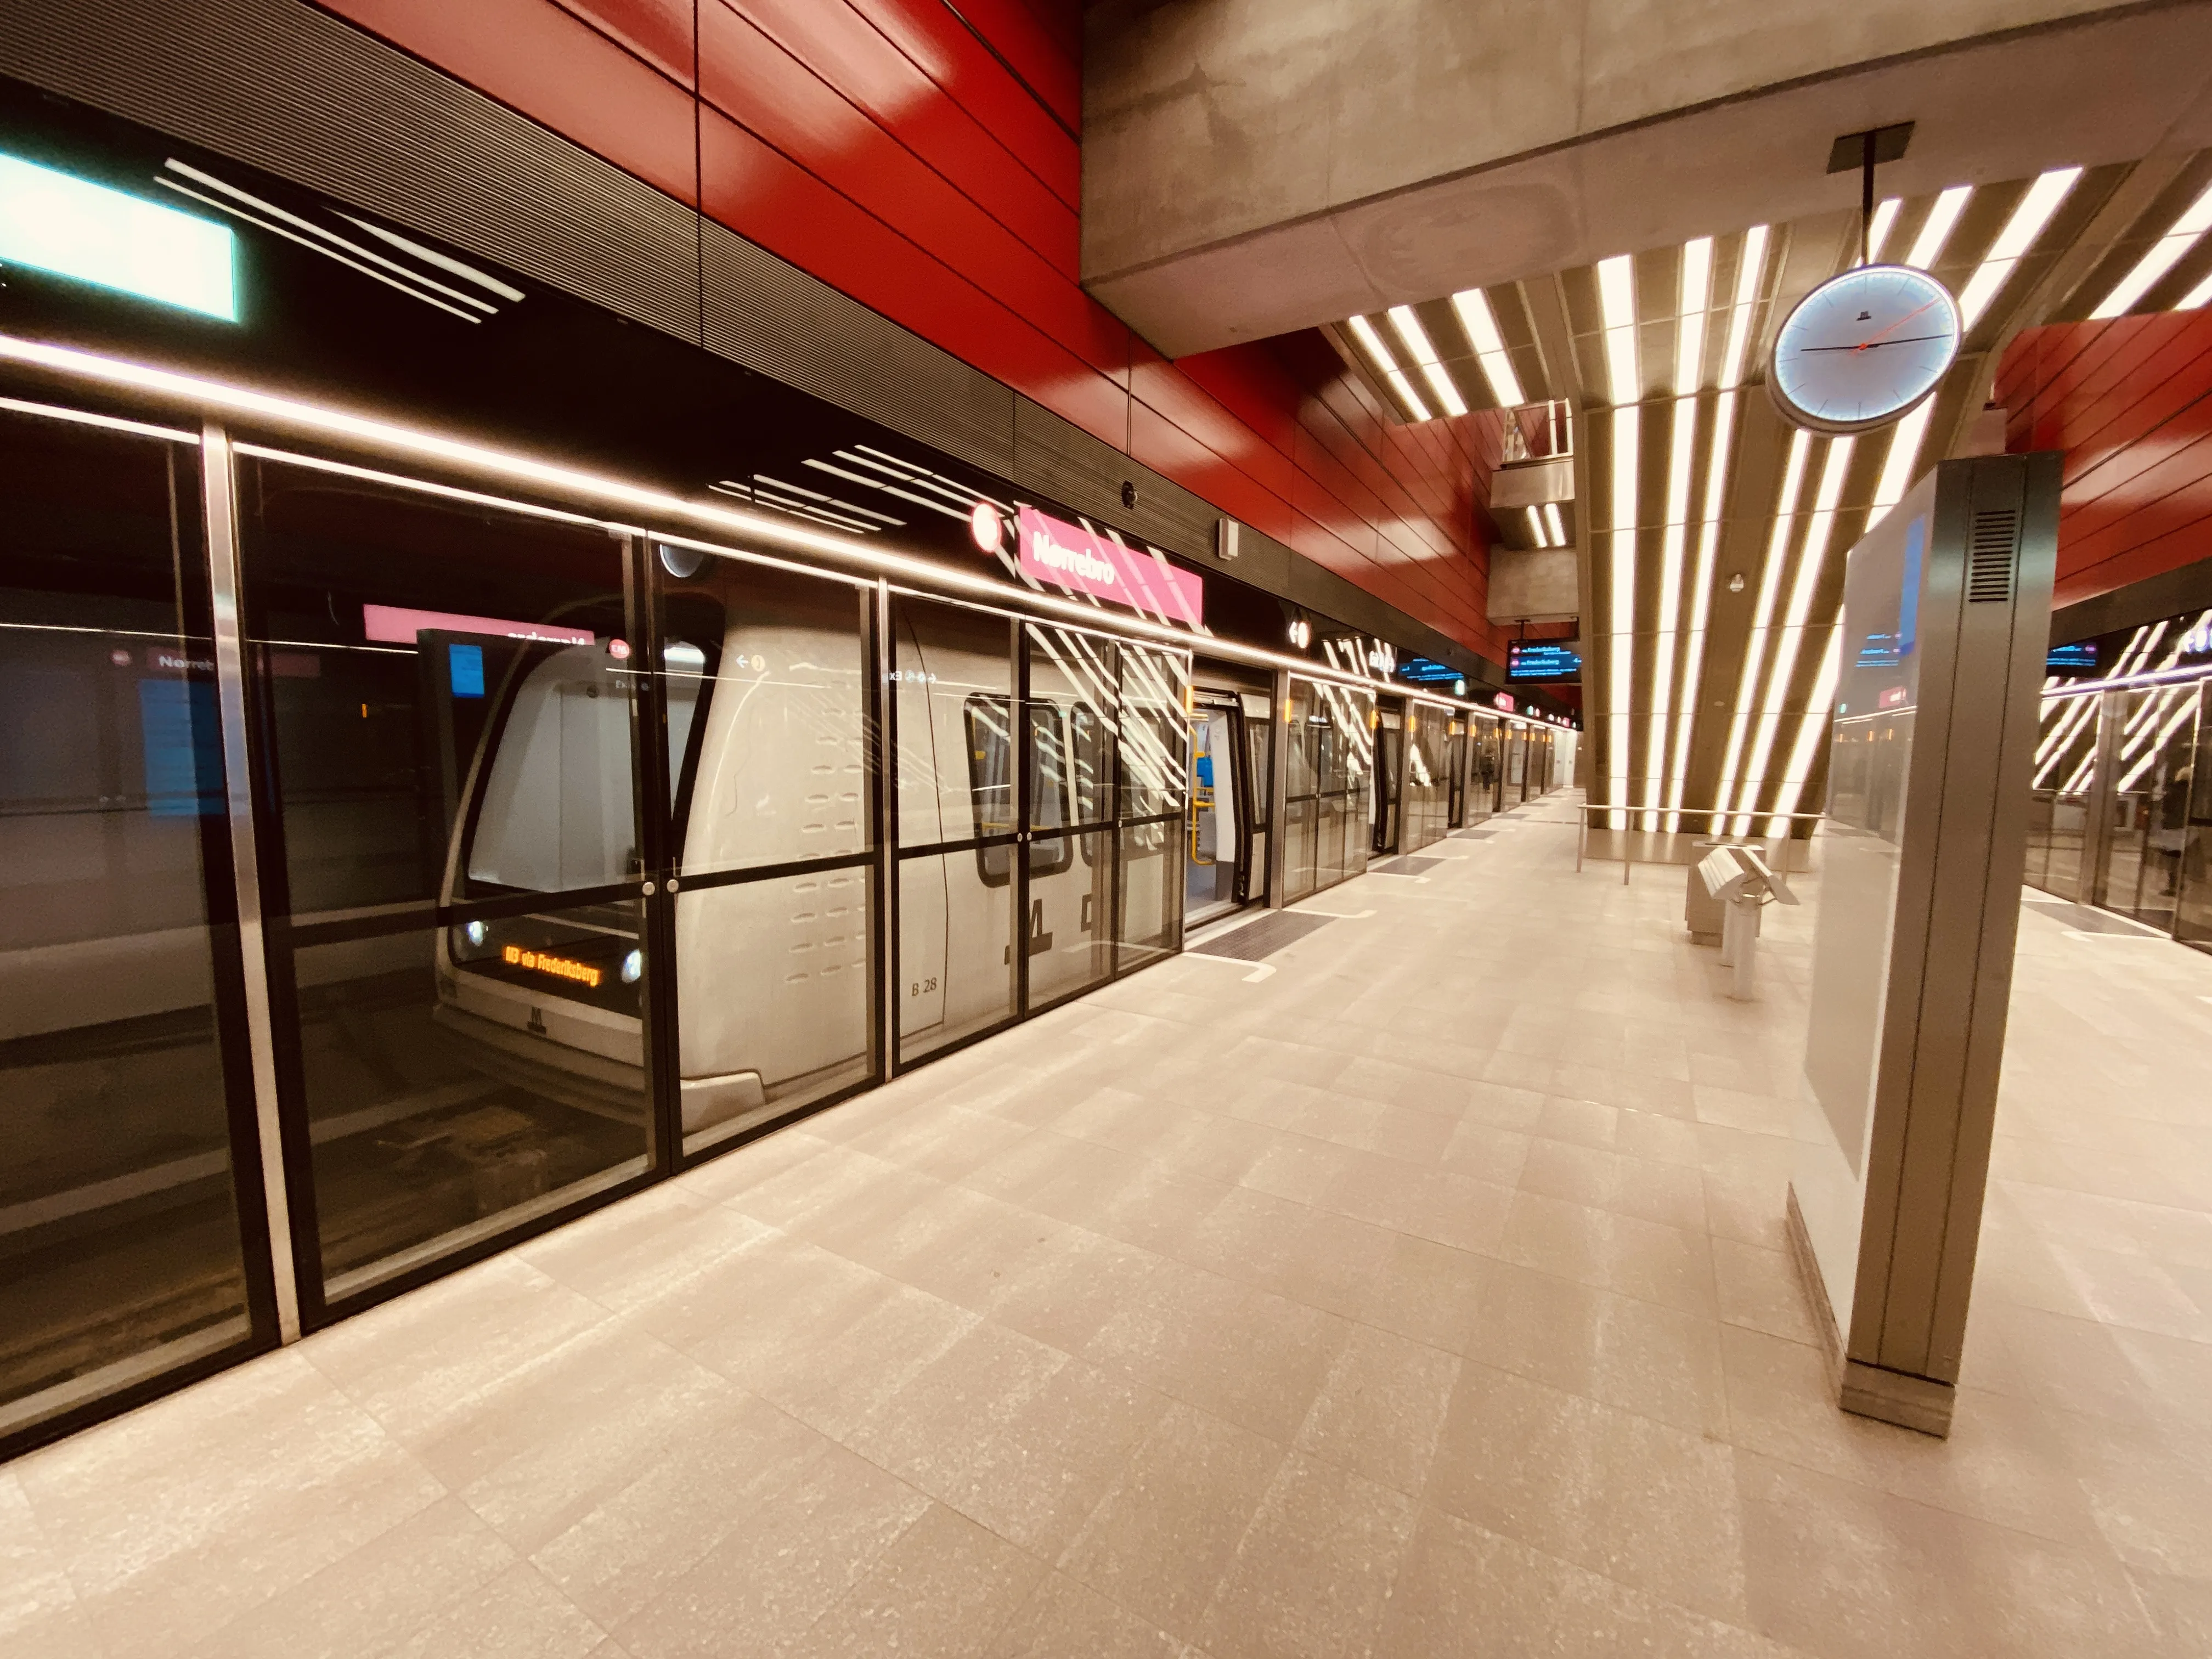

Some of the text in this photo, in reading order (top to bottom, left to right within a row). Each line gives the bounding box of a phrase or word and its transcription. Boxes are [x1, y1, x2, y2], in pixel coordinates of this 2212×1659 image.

[505, 946, 600, 987] M3 via Frederiksberg
[912, 977, 937, 997] B 28
